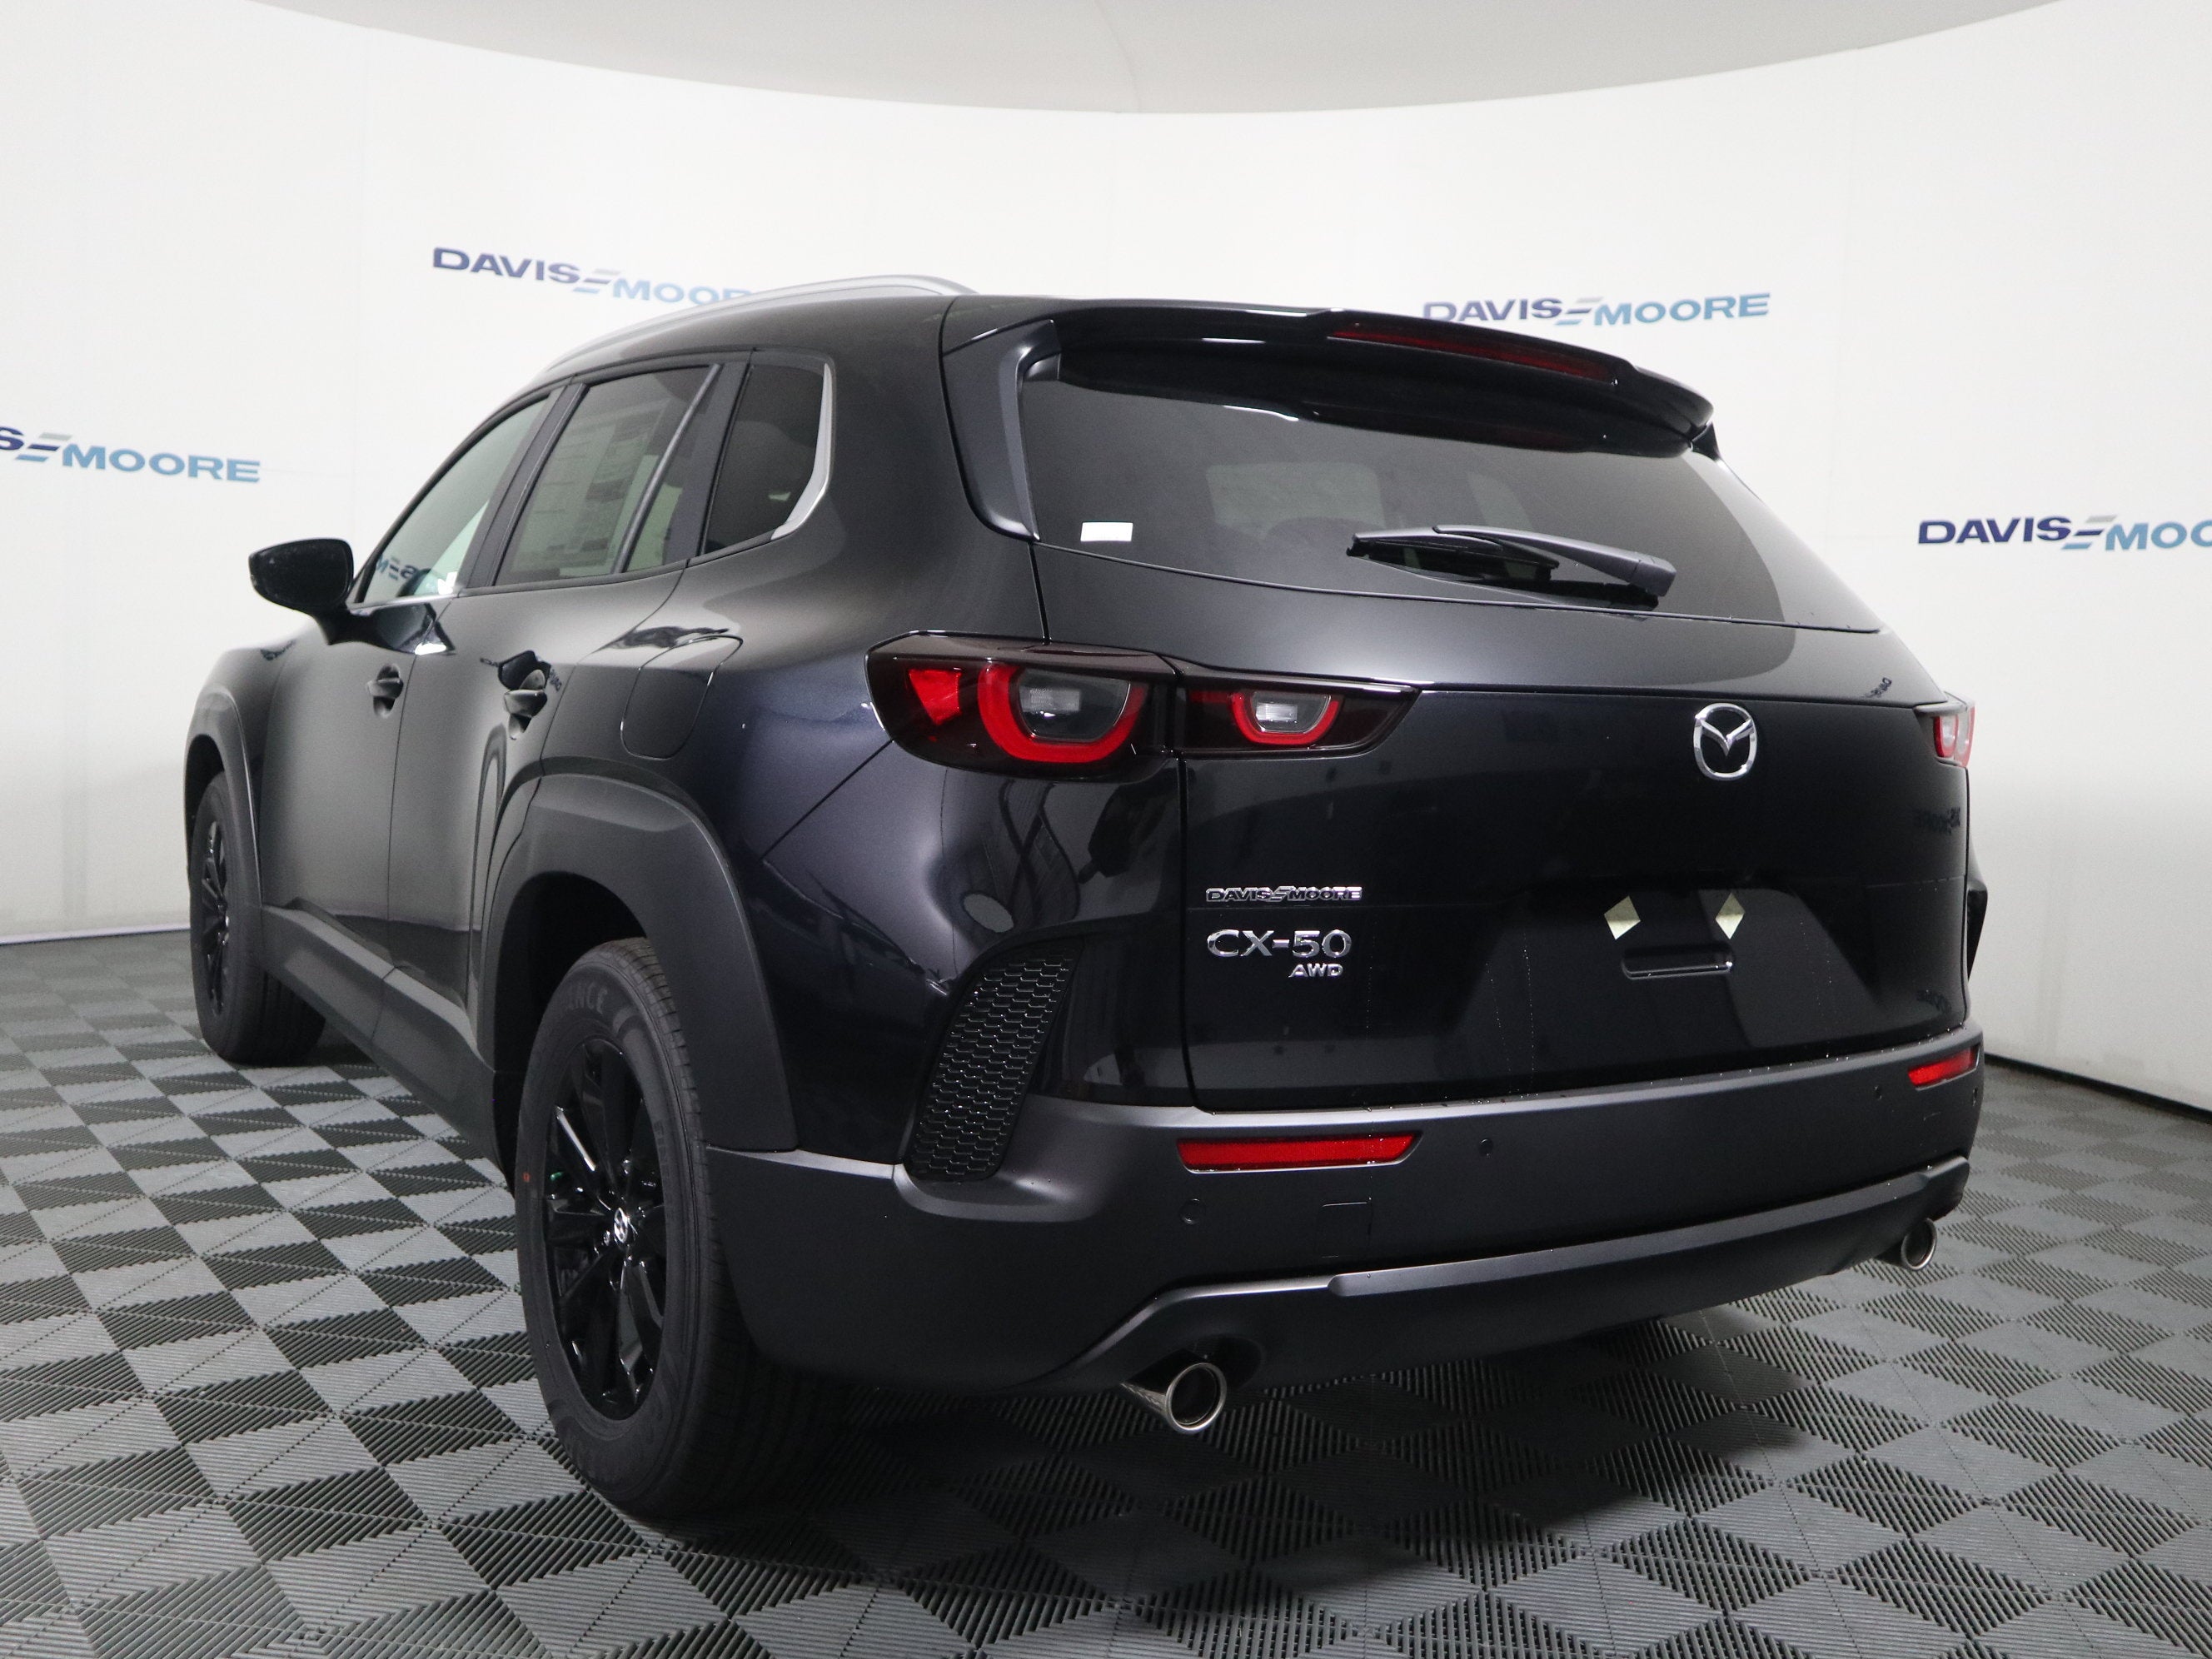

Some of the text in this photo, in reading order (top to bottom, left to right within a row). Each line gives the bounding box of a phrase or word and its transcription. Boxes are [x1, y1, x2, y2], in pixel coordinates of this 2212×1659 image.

[432, 247, 754, 306] DAVIS MOO
[1422, 292, 1771, 326] DAVIS MOORE
[62, 442, 261, 484] MOORE
[1918, 516, 2212, 551] DAVIS MOO
[1206, 886, 1363, 902] DAVIS MOORE
[1207, 929, 1353, 958] CX-50
[1288, 962, 1343, 978] AWD
